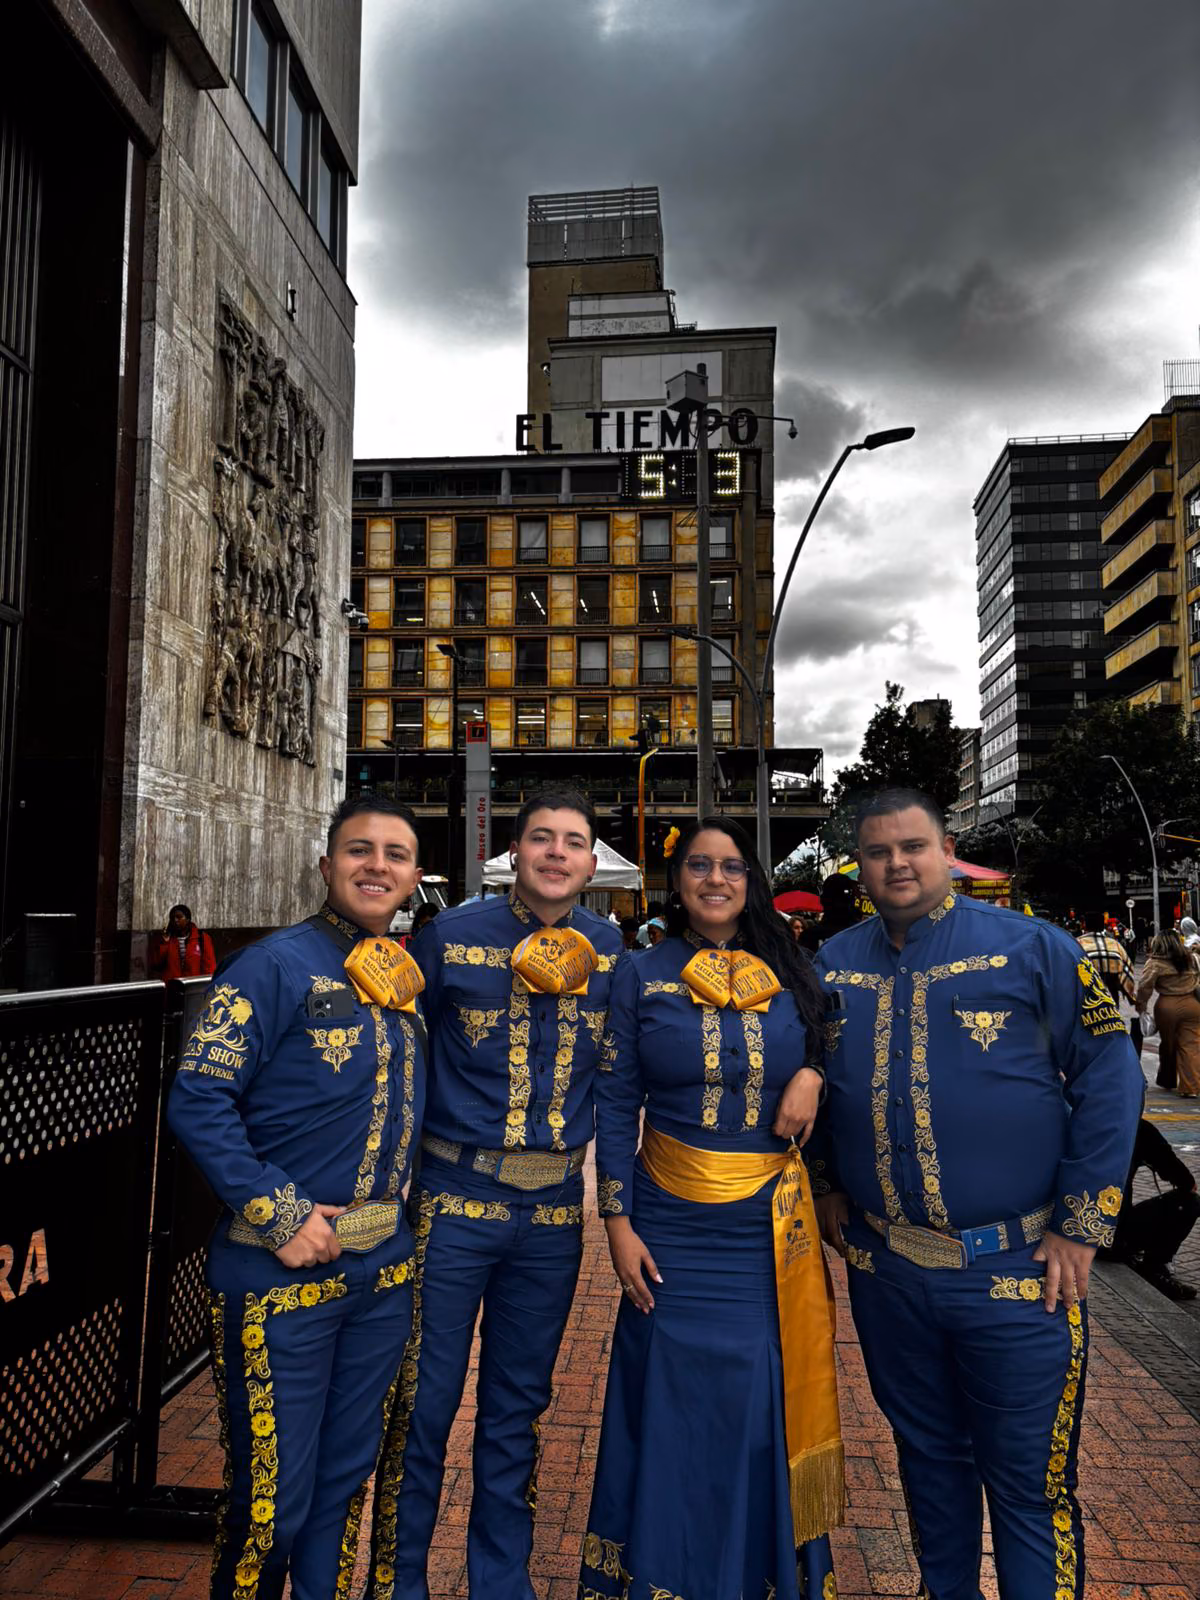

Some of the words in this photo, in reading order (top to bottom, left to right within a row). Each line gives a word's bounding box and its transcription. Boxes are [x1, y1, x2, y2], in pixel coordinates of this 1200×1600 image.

[516, 413, 562, 451] EL
[585, 408, 758, 449] TIEMPO
[476, 797, 486, 813] Oro
[476, 815, 486, 830] del
[476, 833, 486, 860] Museo
[208, 1046, 248, 1069] SHOW
[198, 1063, 235, 1081] JUVENIL
